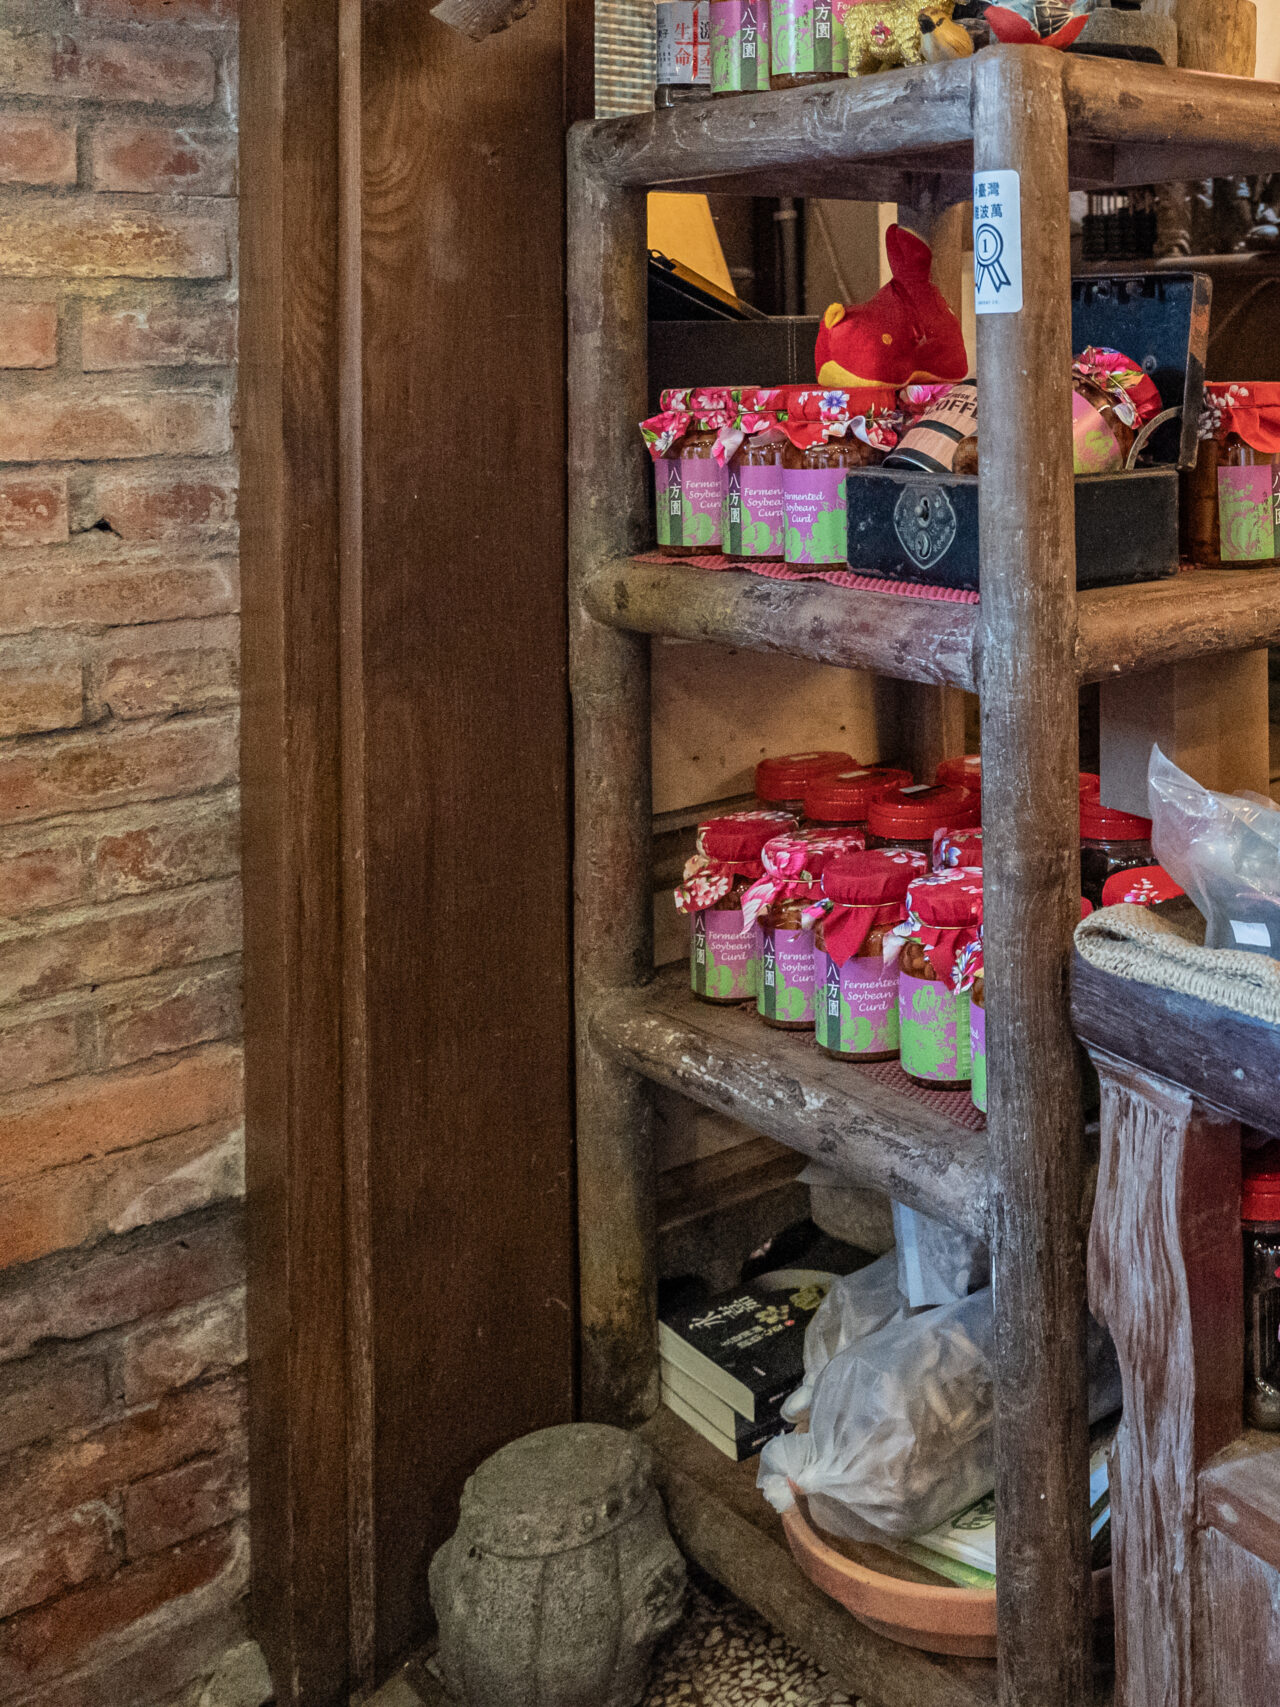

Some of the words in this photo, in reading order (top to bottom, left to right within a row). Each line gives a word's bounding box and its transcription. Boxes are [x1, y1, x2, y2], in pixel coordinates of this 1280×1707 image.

[814, 0, 831, 39] 方園
[740, 8, 757, 58] 八方園
[669, 467, 682, 516] 八方園
[729, 473, 741, 524] 八方園
[791, 513, 813, 523] Curd
[696, 915, 705, 965] 八方園
[711, 941, 753, 953] Soybean
[721, 951, 748, 961] Curd
[764, 936, 775, 986] 八方園
[778, 951, 815, 961] Fermen
[792, 974, 815, 983] Cur
[827, 962, 840, 1017] 八方園
[847, 990, 894, 1003] Soybean
[858, 1000, 889, 1012] Curd
